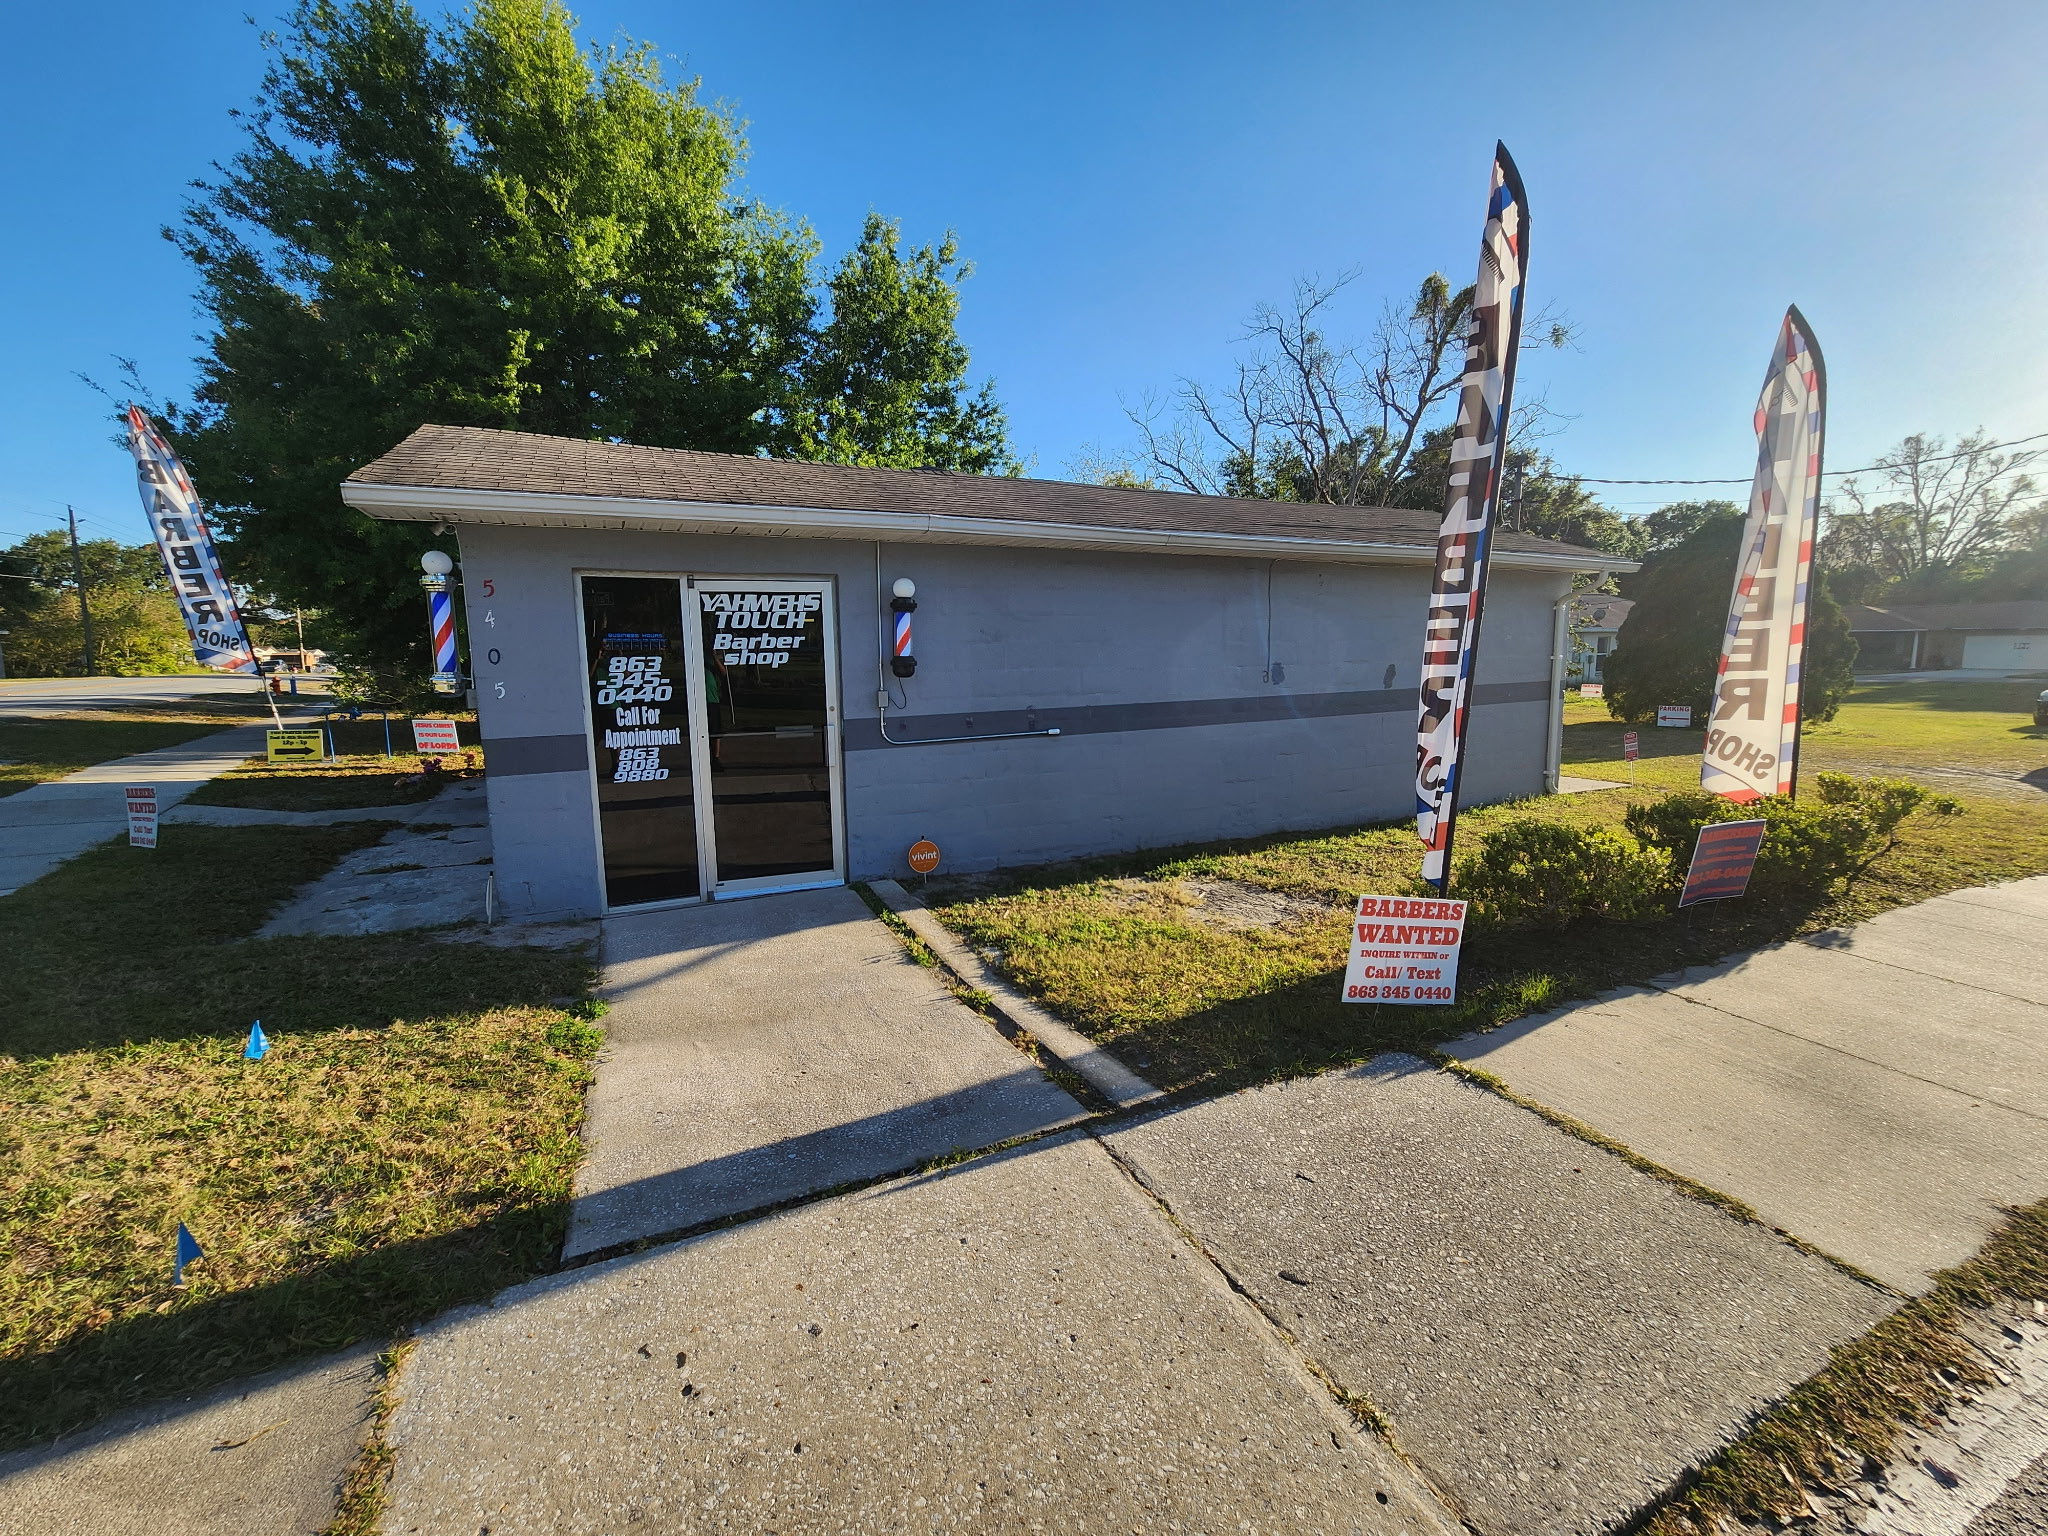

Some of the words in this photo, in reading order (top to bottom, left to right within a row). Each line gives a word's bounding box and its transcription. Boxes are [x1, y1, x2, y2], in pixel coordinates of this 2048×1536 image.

[700, 593, 821, 612] YAHWEHS
[715, 611, 806, 629] TOUCH
[713, 633, 806, 650] Barber
[608, 656, 662, 673] 863
[724, 649, 790, 668] shop
[597, 685, 673, 705] 0440
[615, 706, 641, 727] Call
[642, 706, 661, 725] For
[1659, 705, 1690, 713] PARKING
[605, 727, 681, 750] Appointment
[618, 747, 660, 760] 863
[617, 758, 660, 772] 808
[613, 768, 669, 784] 9880
[912, 850, 938, 862] vivint
[1360, 898, 1465, 920] BARBERS
[1357, 924, 1460, 946] WANTED
[1360, 950, 1401, 959] INQUIRE
[1403, 951, 1438, 960] WITHIN
[1407, 966, 1442, 980] Text
[1347, 985, 1378, 998] 863
[1381, 986, 1411, 999] 345
[1414, 986, 1452, 1000] 0440
